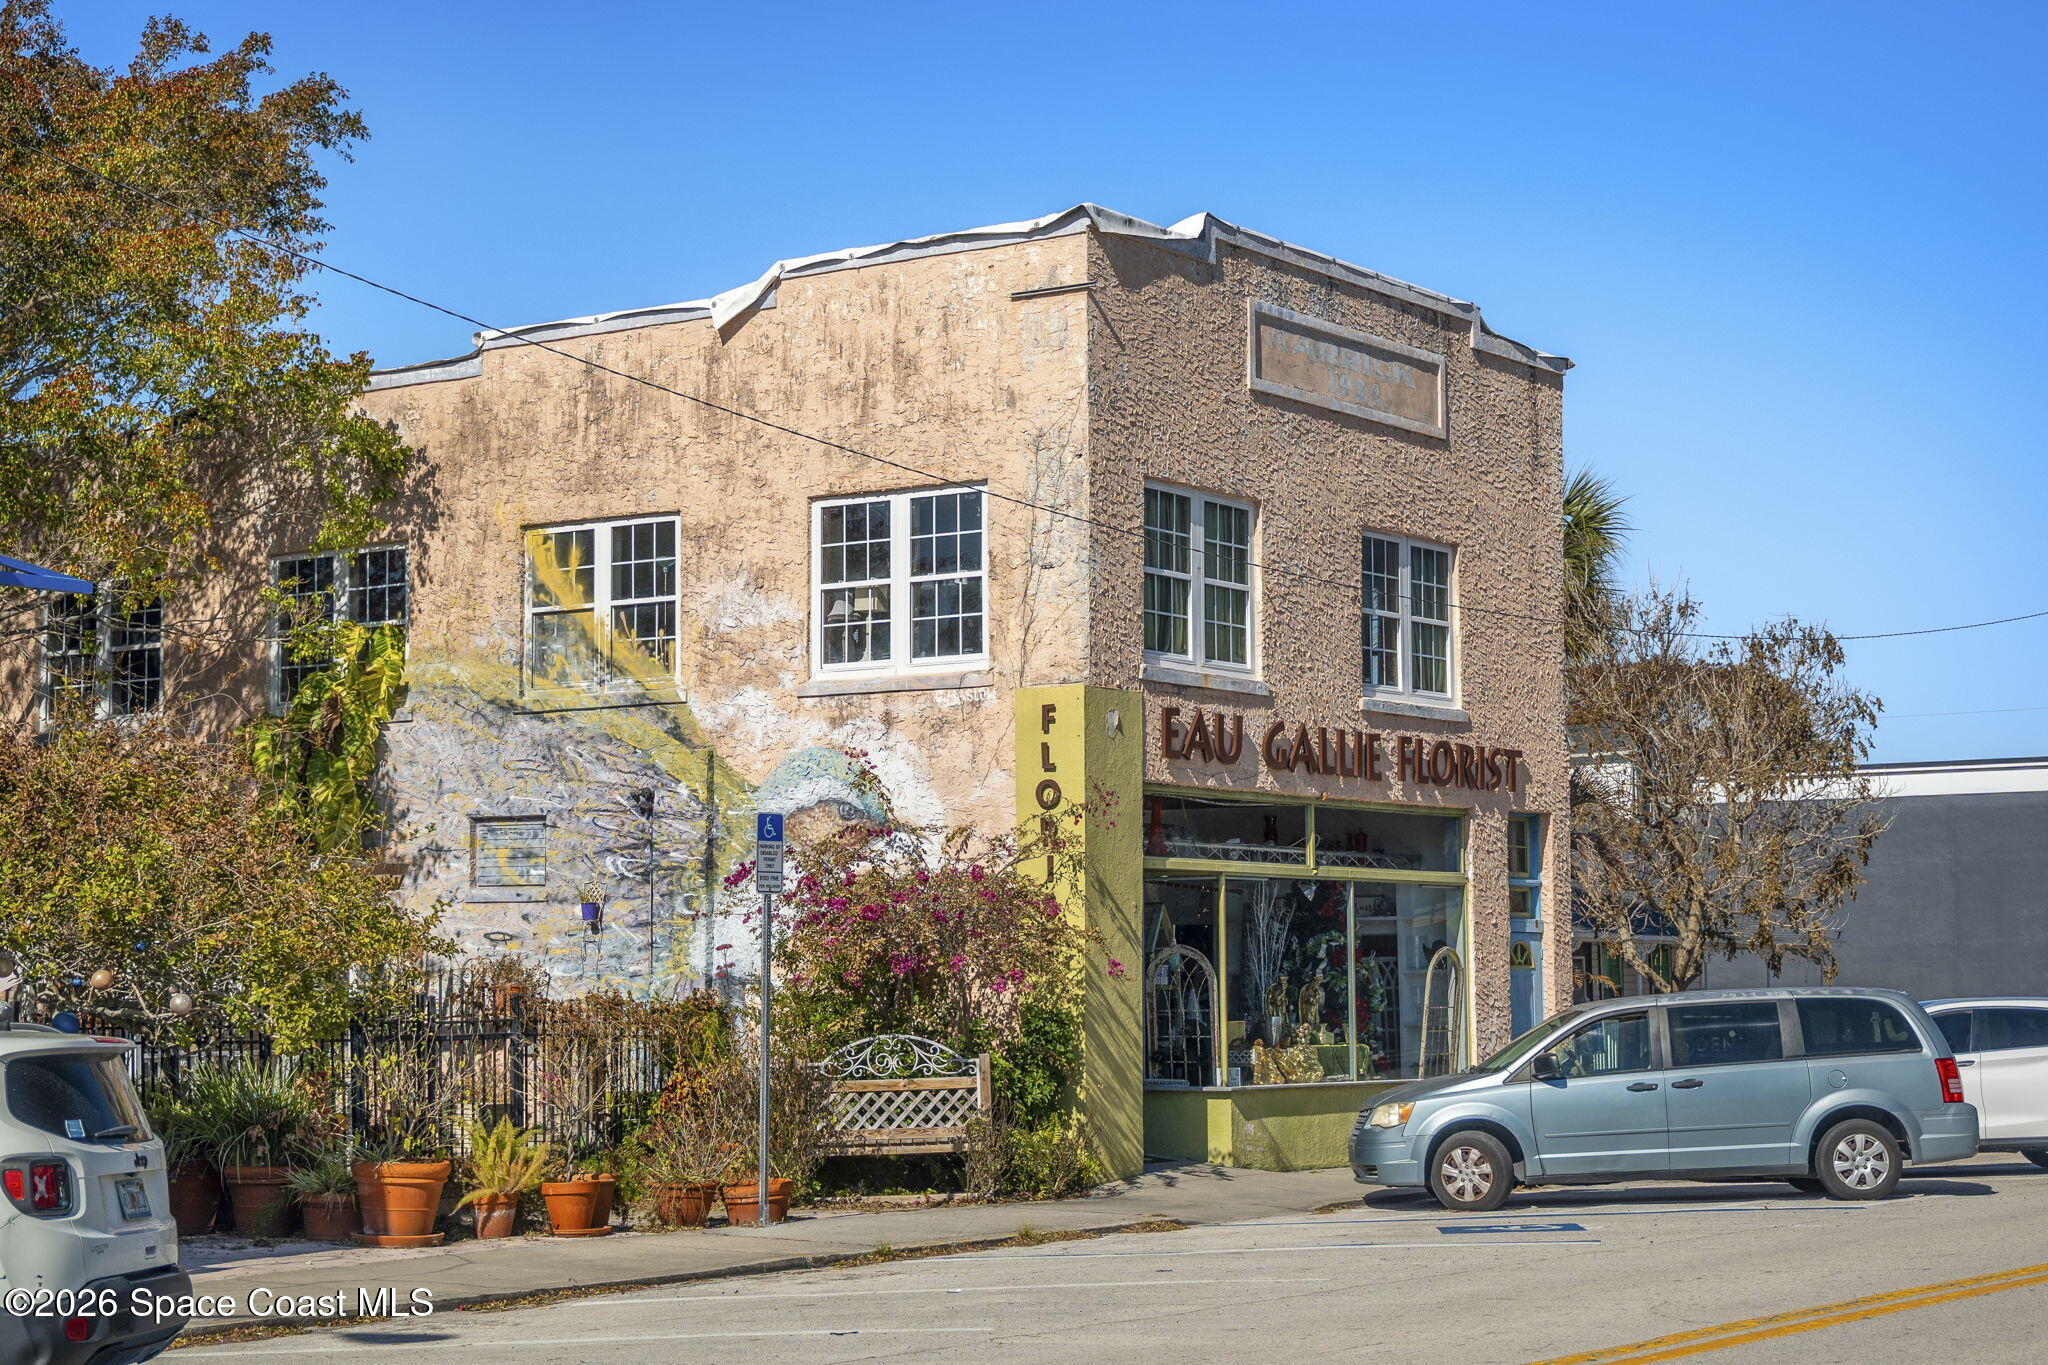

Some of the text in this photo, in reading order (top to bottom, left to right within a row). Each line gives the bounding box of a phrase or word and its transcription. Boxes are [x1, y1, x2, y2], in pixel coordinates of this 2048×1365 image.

[1160, 707, 1523, 793] EAU GALLIE FLORIST
